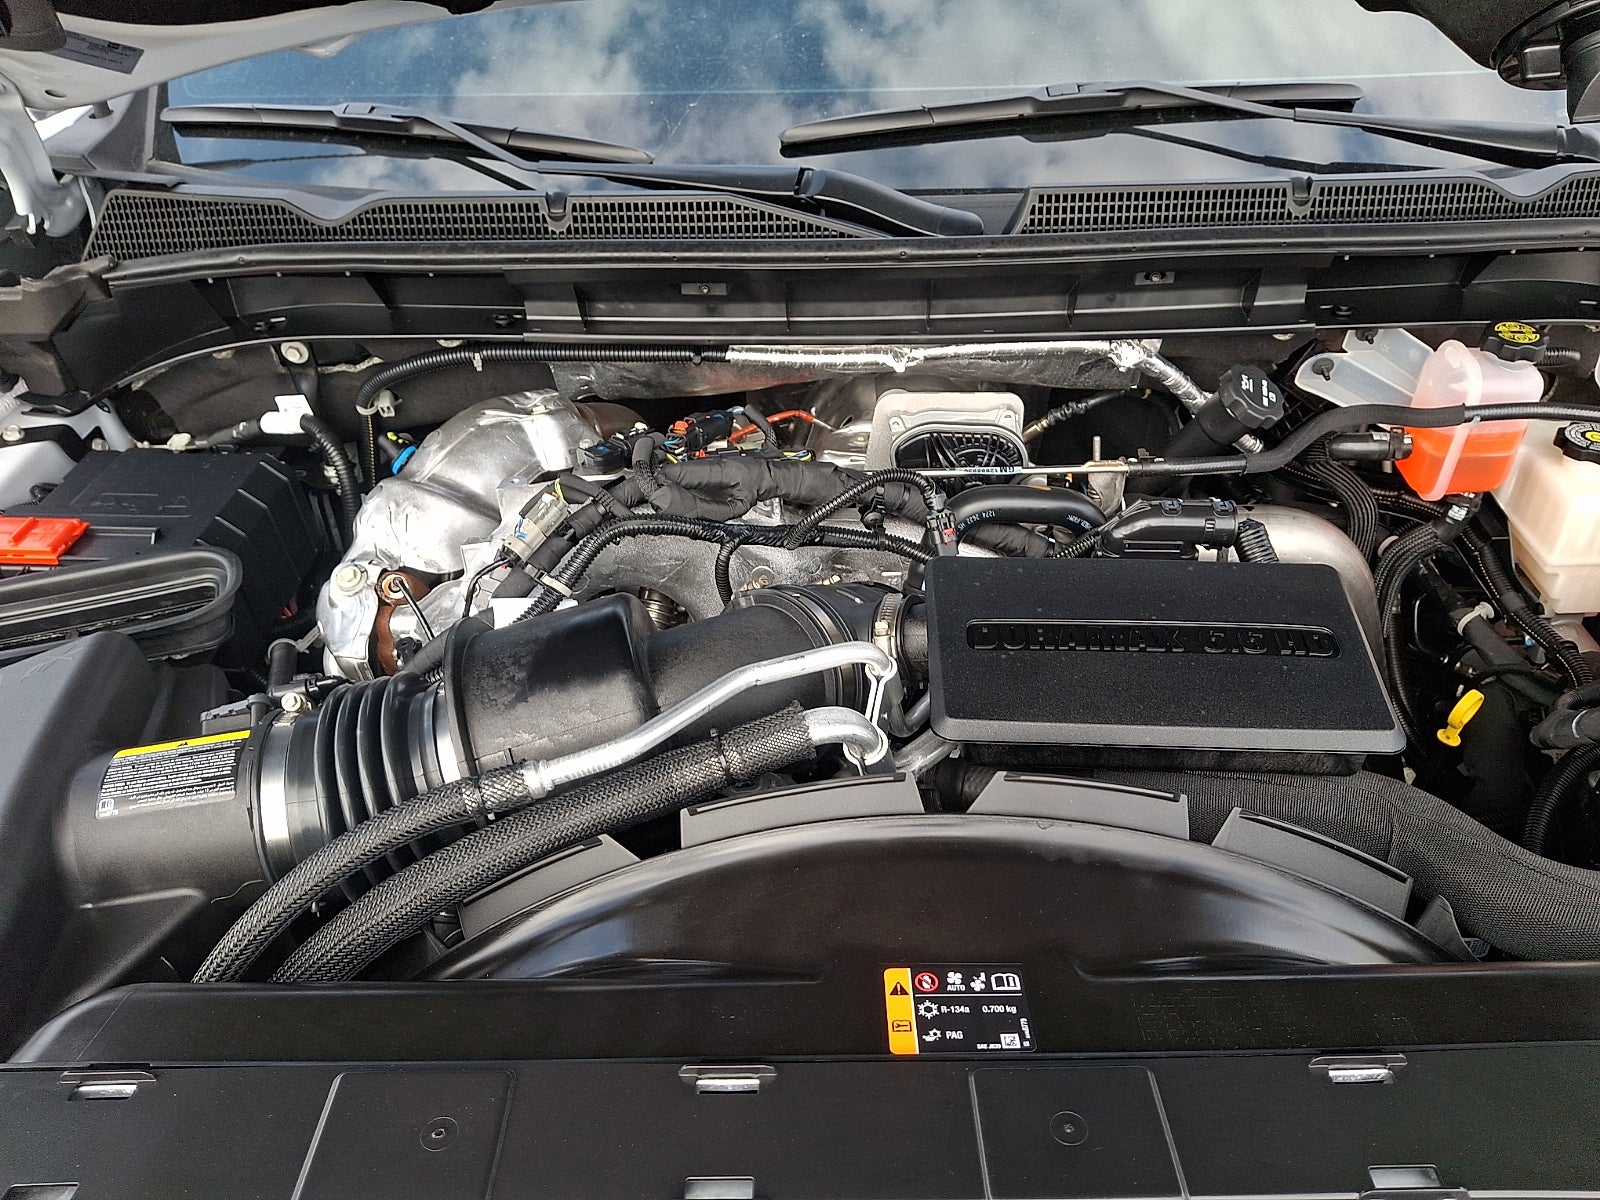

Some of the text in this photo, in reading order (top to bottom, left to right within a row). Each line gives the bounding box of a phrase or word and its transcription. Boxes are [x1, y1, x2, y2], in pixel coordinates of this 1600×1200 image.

[974, 626, 1185, 652] DURAMAX
[1275, 631, 1334, 657] HD
[947, 984, 966, 992] AUTO
[940, 1005, 1018, 1014] R-134a 0.700 kg
[945, 1031, 964, 1040] PAG
